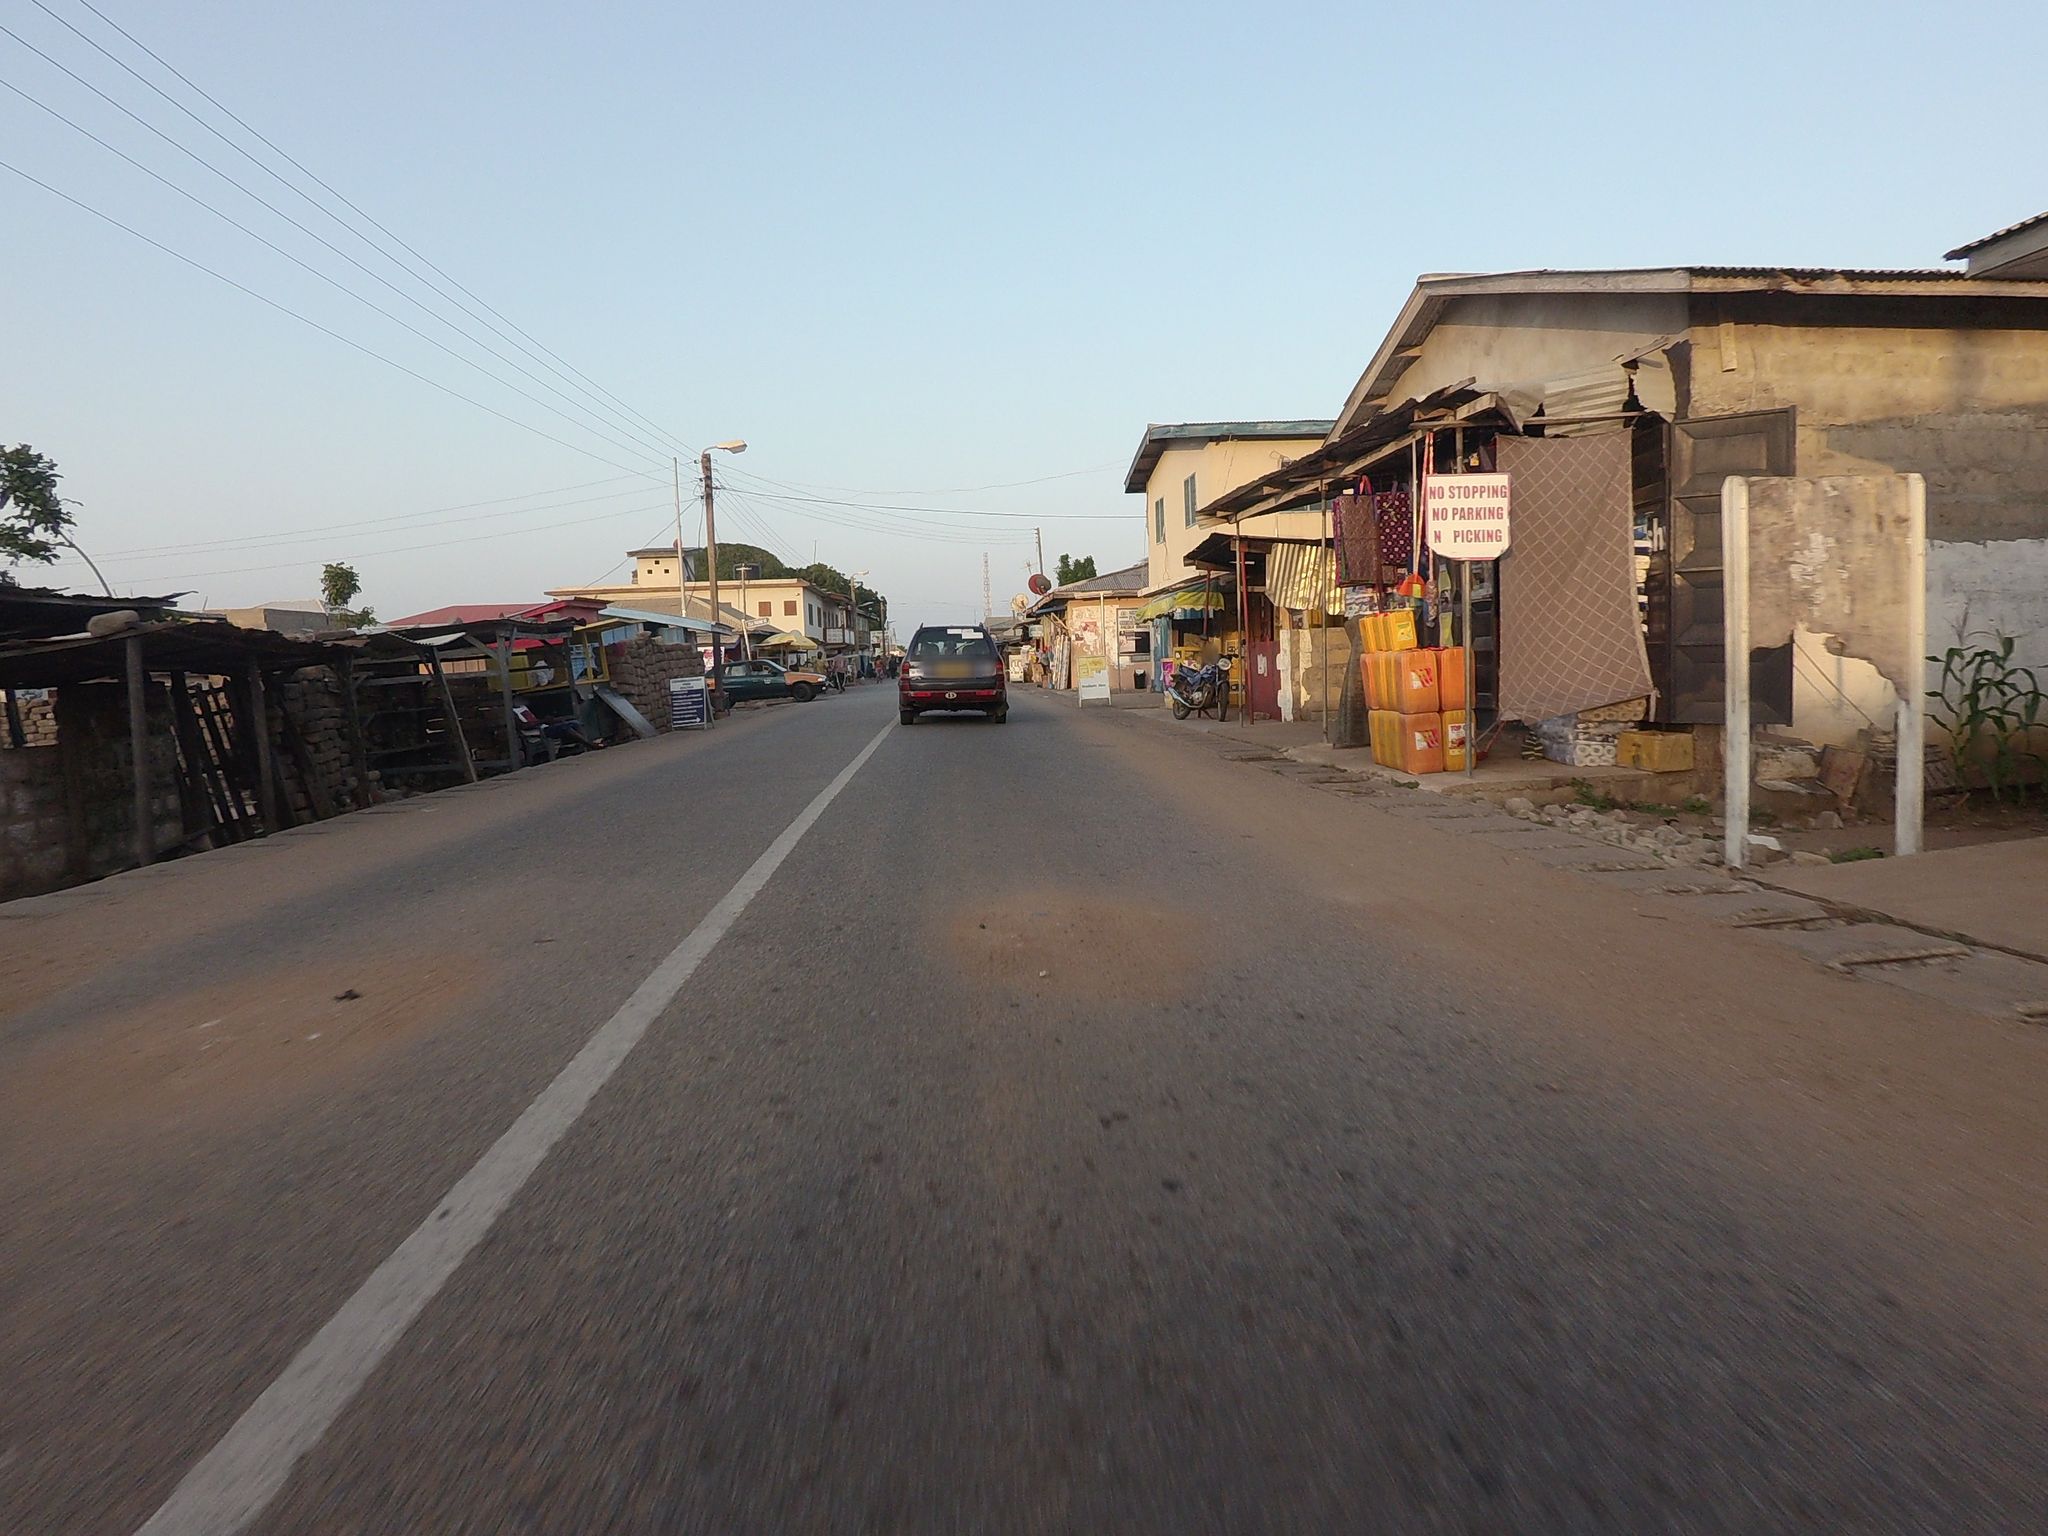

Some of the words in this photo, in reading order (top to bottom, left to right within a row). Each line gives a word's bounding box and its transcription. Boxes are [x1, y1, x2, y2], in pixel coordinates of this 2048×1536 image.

[1429, 486, 1444, 499] NO
[1449, 485, 1508, 499] STOPPING
[1432, 507, 1448, 521] NO
[1452, 507, 1504, 520] PARKING
[1453, 529, 1502, 543] PICKING
